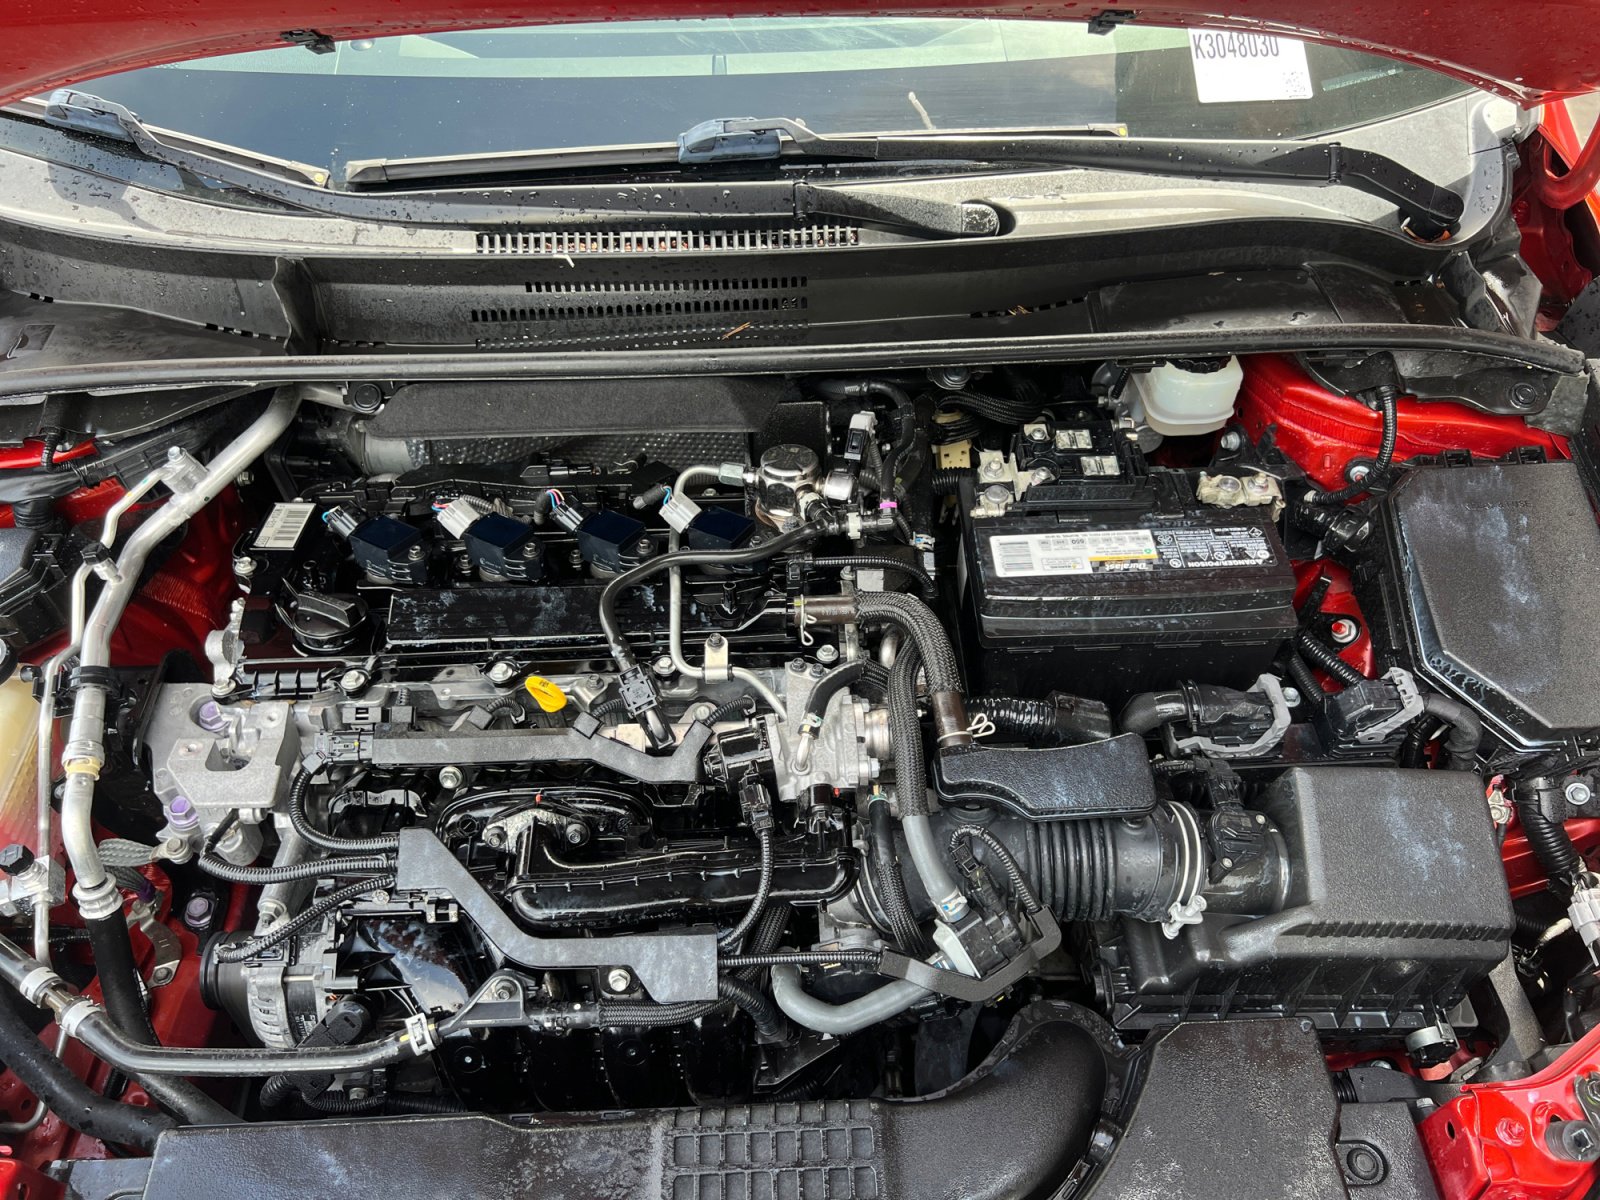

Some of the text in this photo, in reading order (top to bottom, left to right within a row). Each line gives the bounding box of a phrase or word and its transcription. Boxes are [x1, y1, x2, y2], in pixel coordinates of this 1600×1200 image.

[1193, 32, 1280, 59] K3048030
[1104, 561, 1149, 572] Duralast
[1188, 559, 1257, 568] DANGER/POISON
